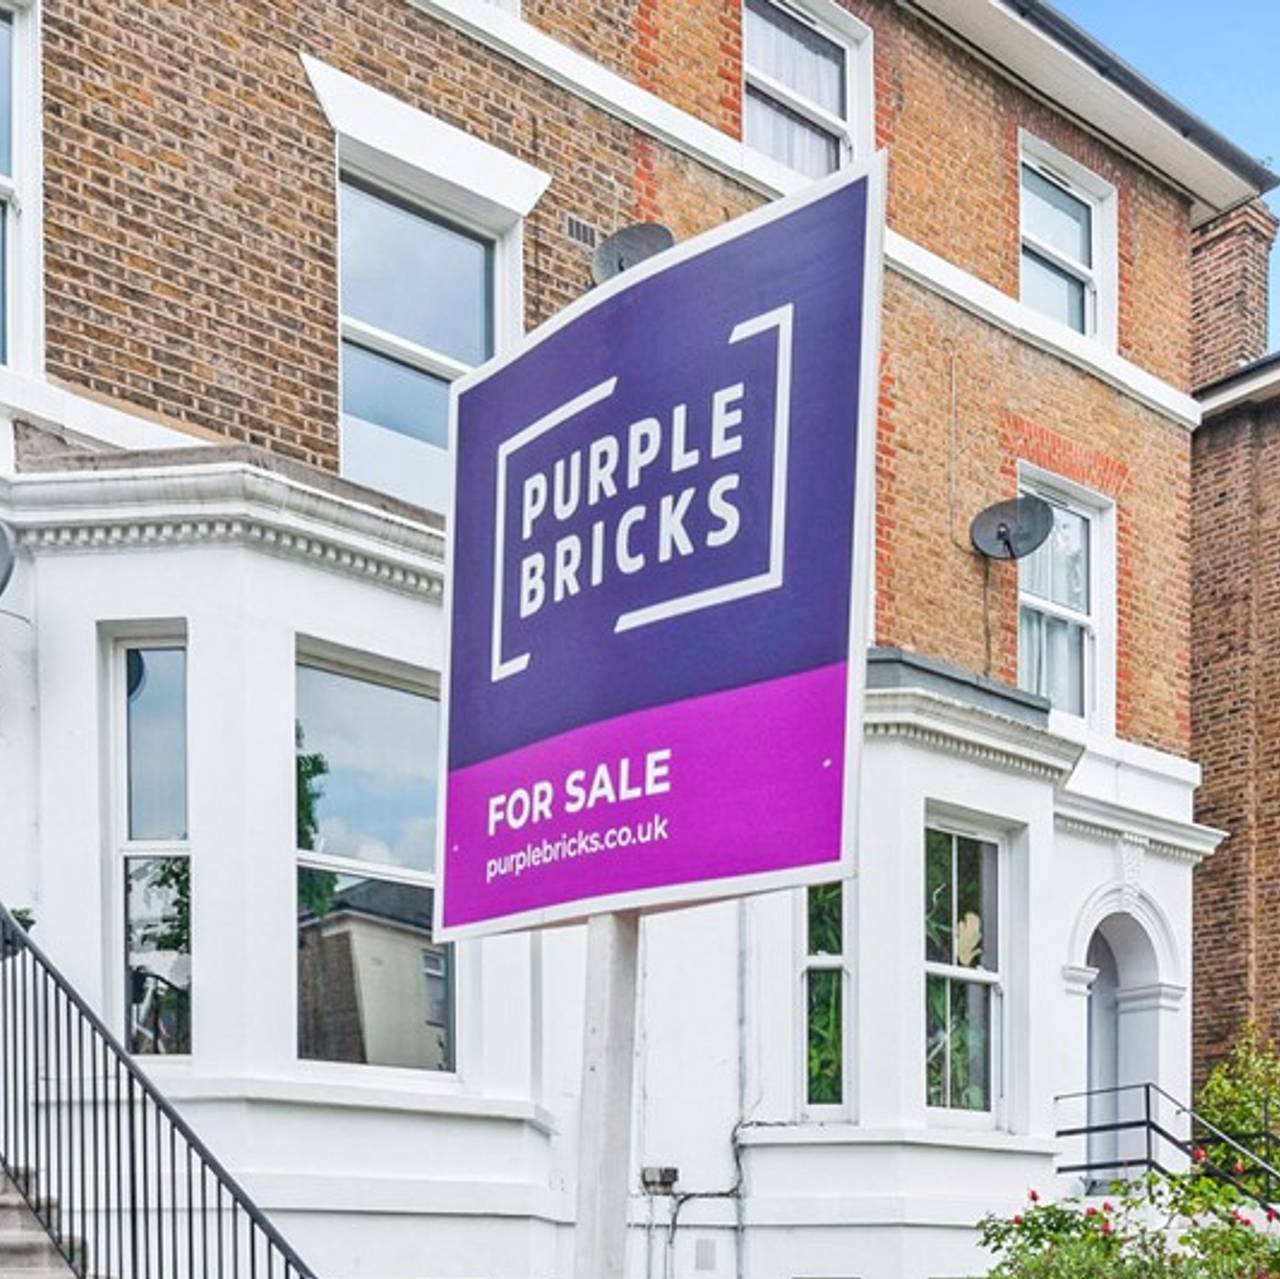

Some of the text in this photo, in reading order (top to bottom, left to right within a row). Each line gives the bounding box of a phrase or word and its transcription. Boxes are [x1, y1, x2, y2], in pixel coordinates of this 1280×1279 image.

[522, 382, 744, 541] PURPLE
[520, 473, 740, 618] BRICKS
[486, 813, 669, 883] purplebricks.co.uk
[488, 749, 671, 836] FOR SALE
